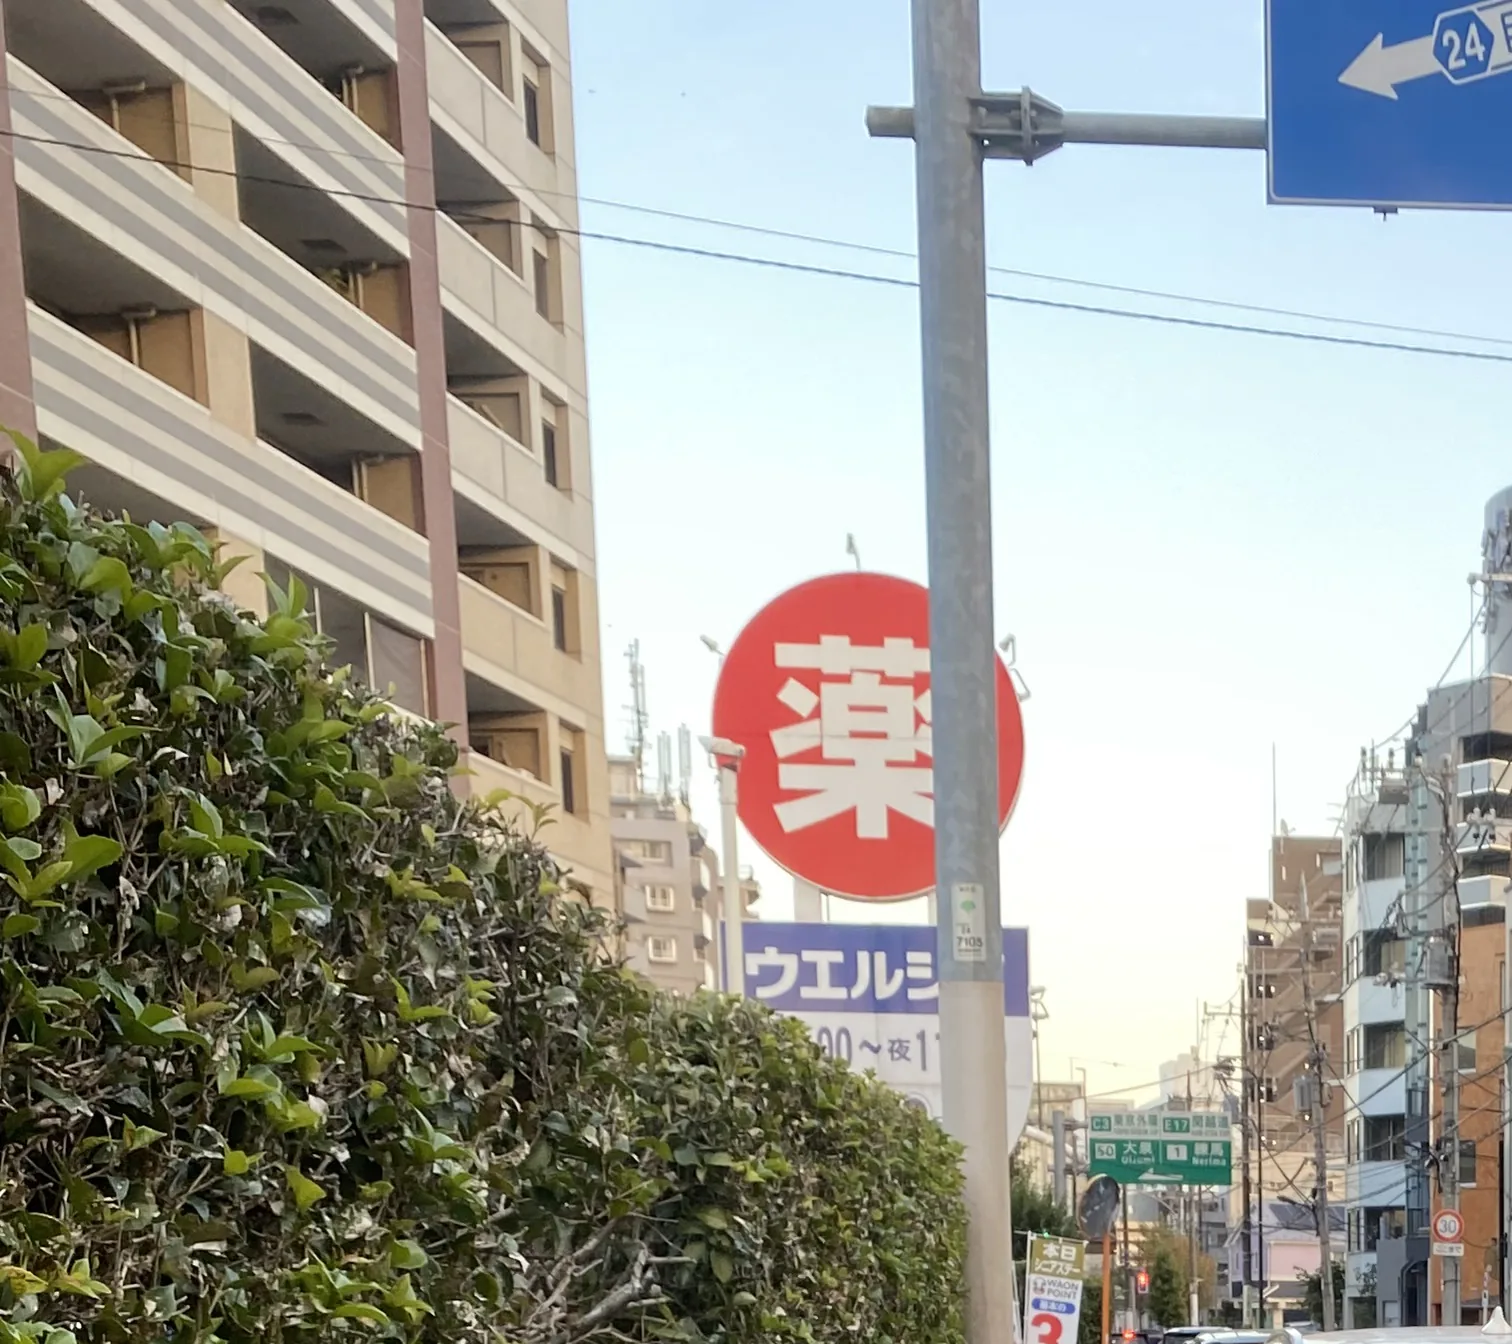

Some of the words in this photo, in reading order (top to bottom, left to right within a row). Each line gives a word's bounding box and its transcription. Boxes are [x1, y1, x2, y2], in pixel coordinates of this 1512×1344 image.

[1442, 21, 1486, 71] 24
[770, 635, 936, 840] 薬
[1164, 1118, 1189, 1131] E17
[1439, 1219, 1457, 1234] 30
[1042, 1242, 1077, 1261] 本日
[1047, 1279, 1079, 1291] WAON
[1046, 1287, 1078, 1300] POINT
